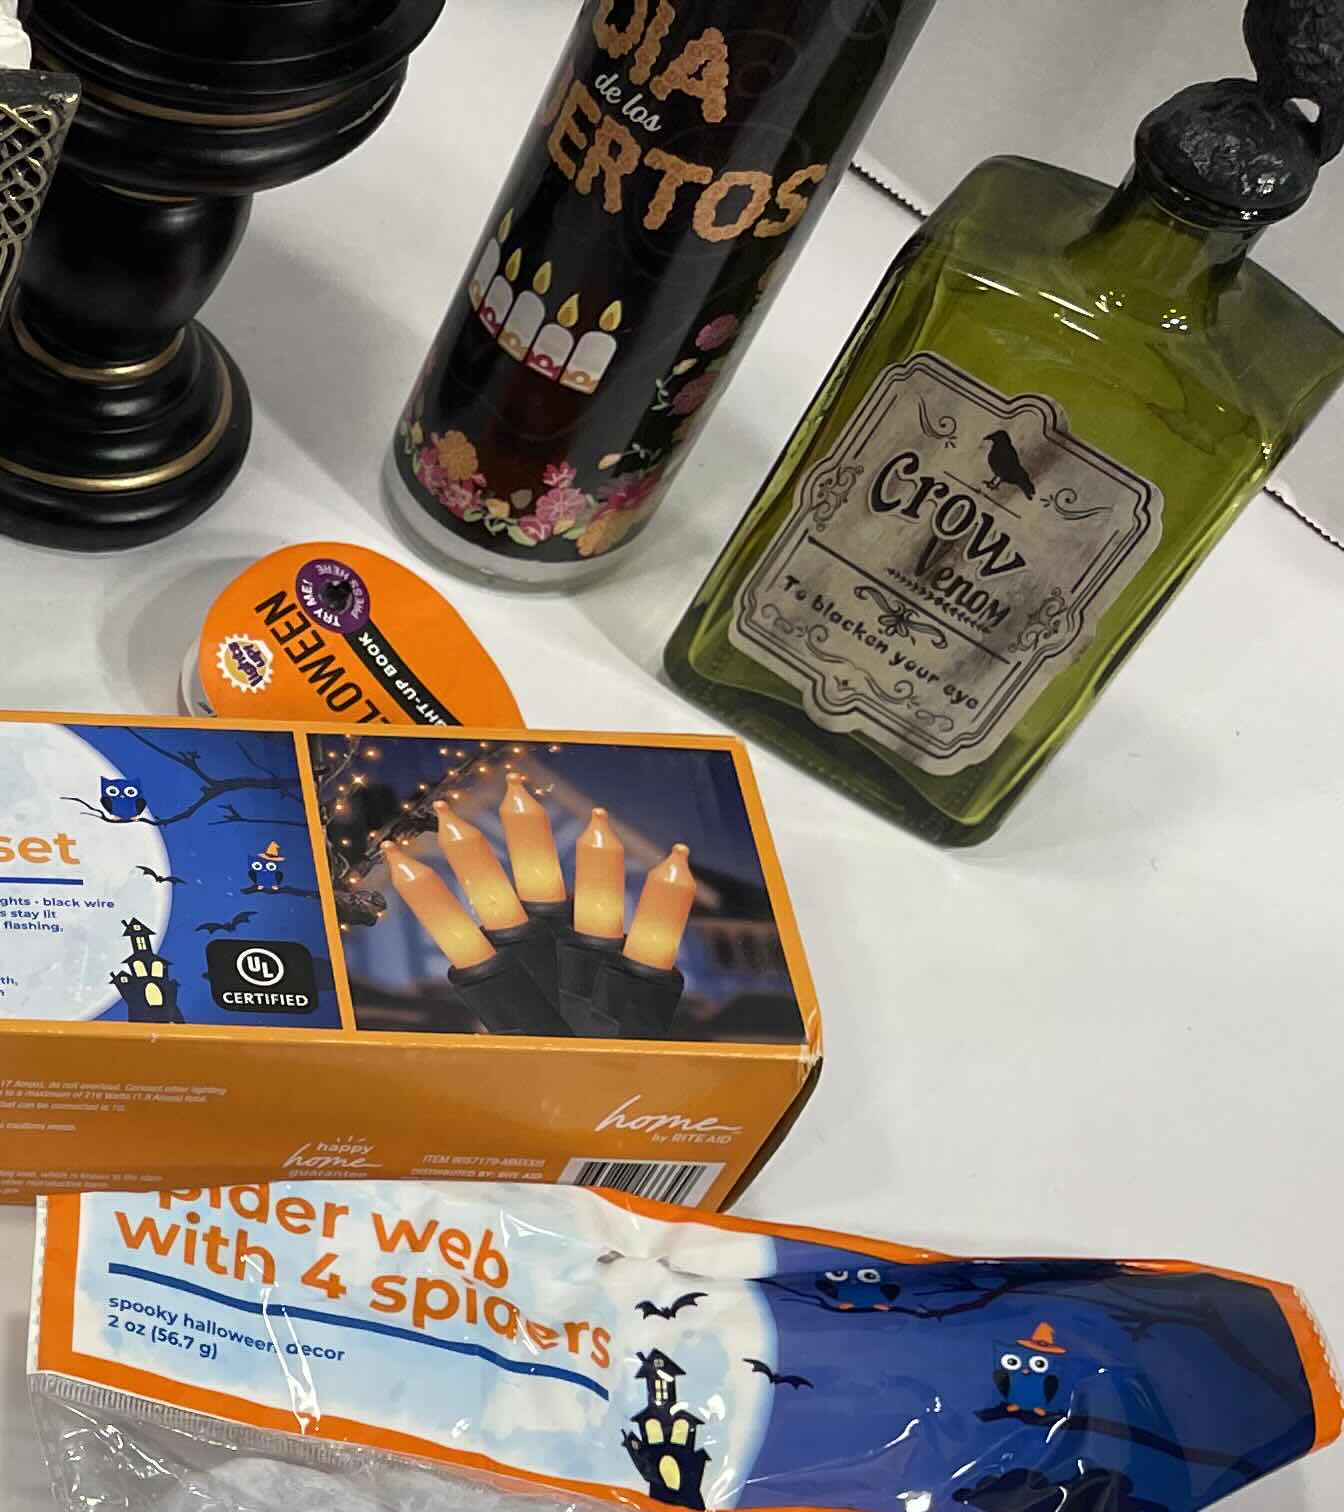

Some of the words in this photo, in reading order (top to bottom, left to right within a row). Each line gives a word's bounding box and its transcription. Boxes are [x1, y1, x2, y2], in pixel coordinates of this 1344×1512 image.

[594, 73, 622, 104] de
[621, 94, 662, 132] los
[547, 80, 829, 242] ERTOS
[870, 451, 1026, 577] Crow
[301, 579, 317, 606] ME!
[313, 608, 341, 627] TRY
[357, 631, 398, 677] BOOK
[783, 574, 808, 601] To
[811, 593, 889, 655] blacken
[888, 651, 940, 686] your
[943, 683, 979, 711] eye
[43, 897, 79, 907] black
[84, 899, 115, 908] wire
[221, 990, 309, 1009] CERTIFIED
[594, 1094, 743, 1132] home
[282, 1143, 382, 1168] home
[317, 1141, 376, 1154] happy
[142, 1185, 349, 1239] pider
[371, 1211, 510, 1289] web
[114, 1210, 276, 1286] with
[300, 1253, 347, 1299] 4
[369, 1274, 614, 1369] spiders
[108, 1296, 177, 1324] spooky
[183, 1314, 277, 1354] halloween
[286, 1341, 346, 1362] decor
[108, 1315, 119, 1329] 2
[123, 1320, 146, 1336] oz
[150, 1324, 194, 1354] (56.7
[199, 1340, 218, 1361] g)
